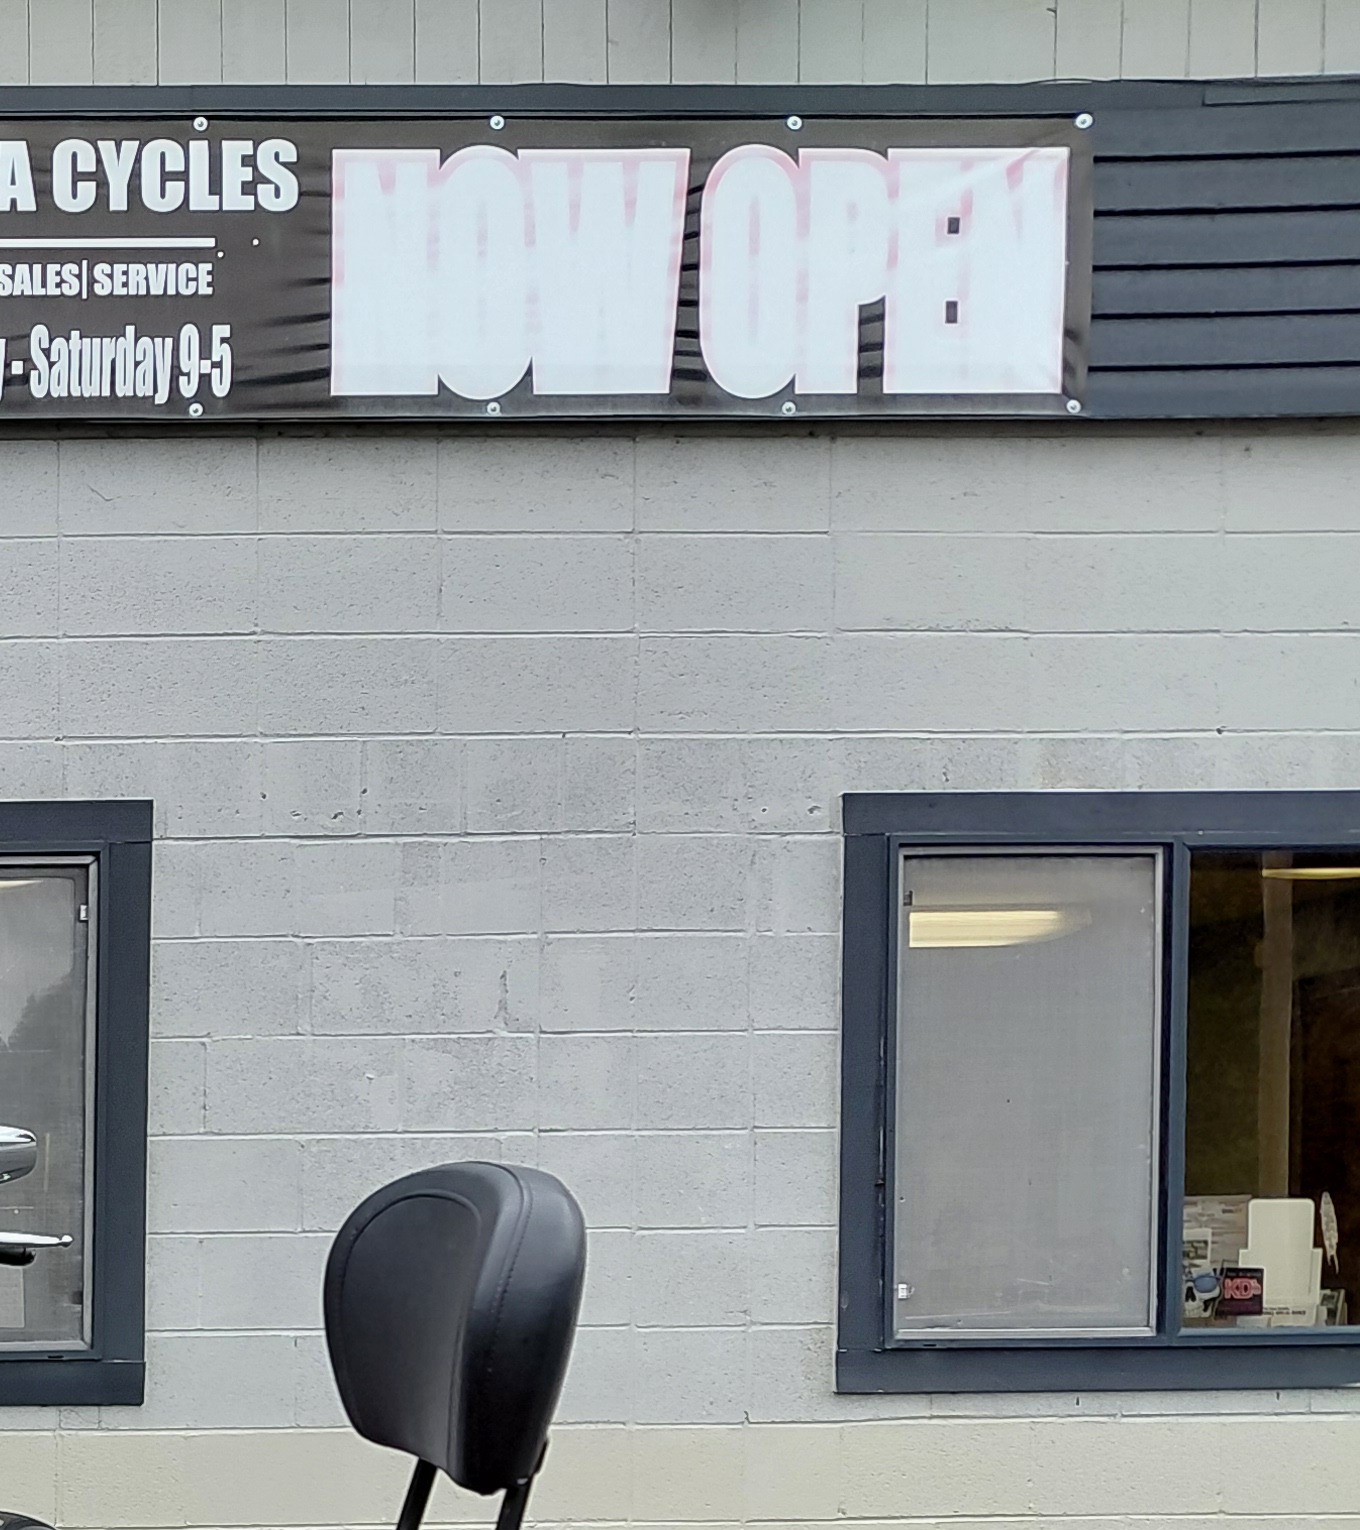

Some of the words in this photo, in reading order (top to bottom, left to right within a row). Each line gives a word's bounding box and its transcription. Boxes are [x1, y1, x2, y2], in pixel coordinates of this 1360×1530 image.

[51, 138, 300, 214] CYCLES
[92, 263, 214, 296] SERVICE
[331, 144, 691, 400] NOW
[699, 144, 1071, 398] OPEN
[29, 324, 175, 404] Saturday
[179, 324, 233, 397] 9-5
